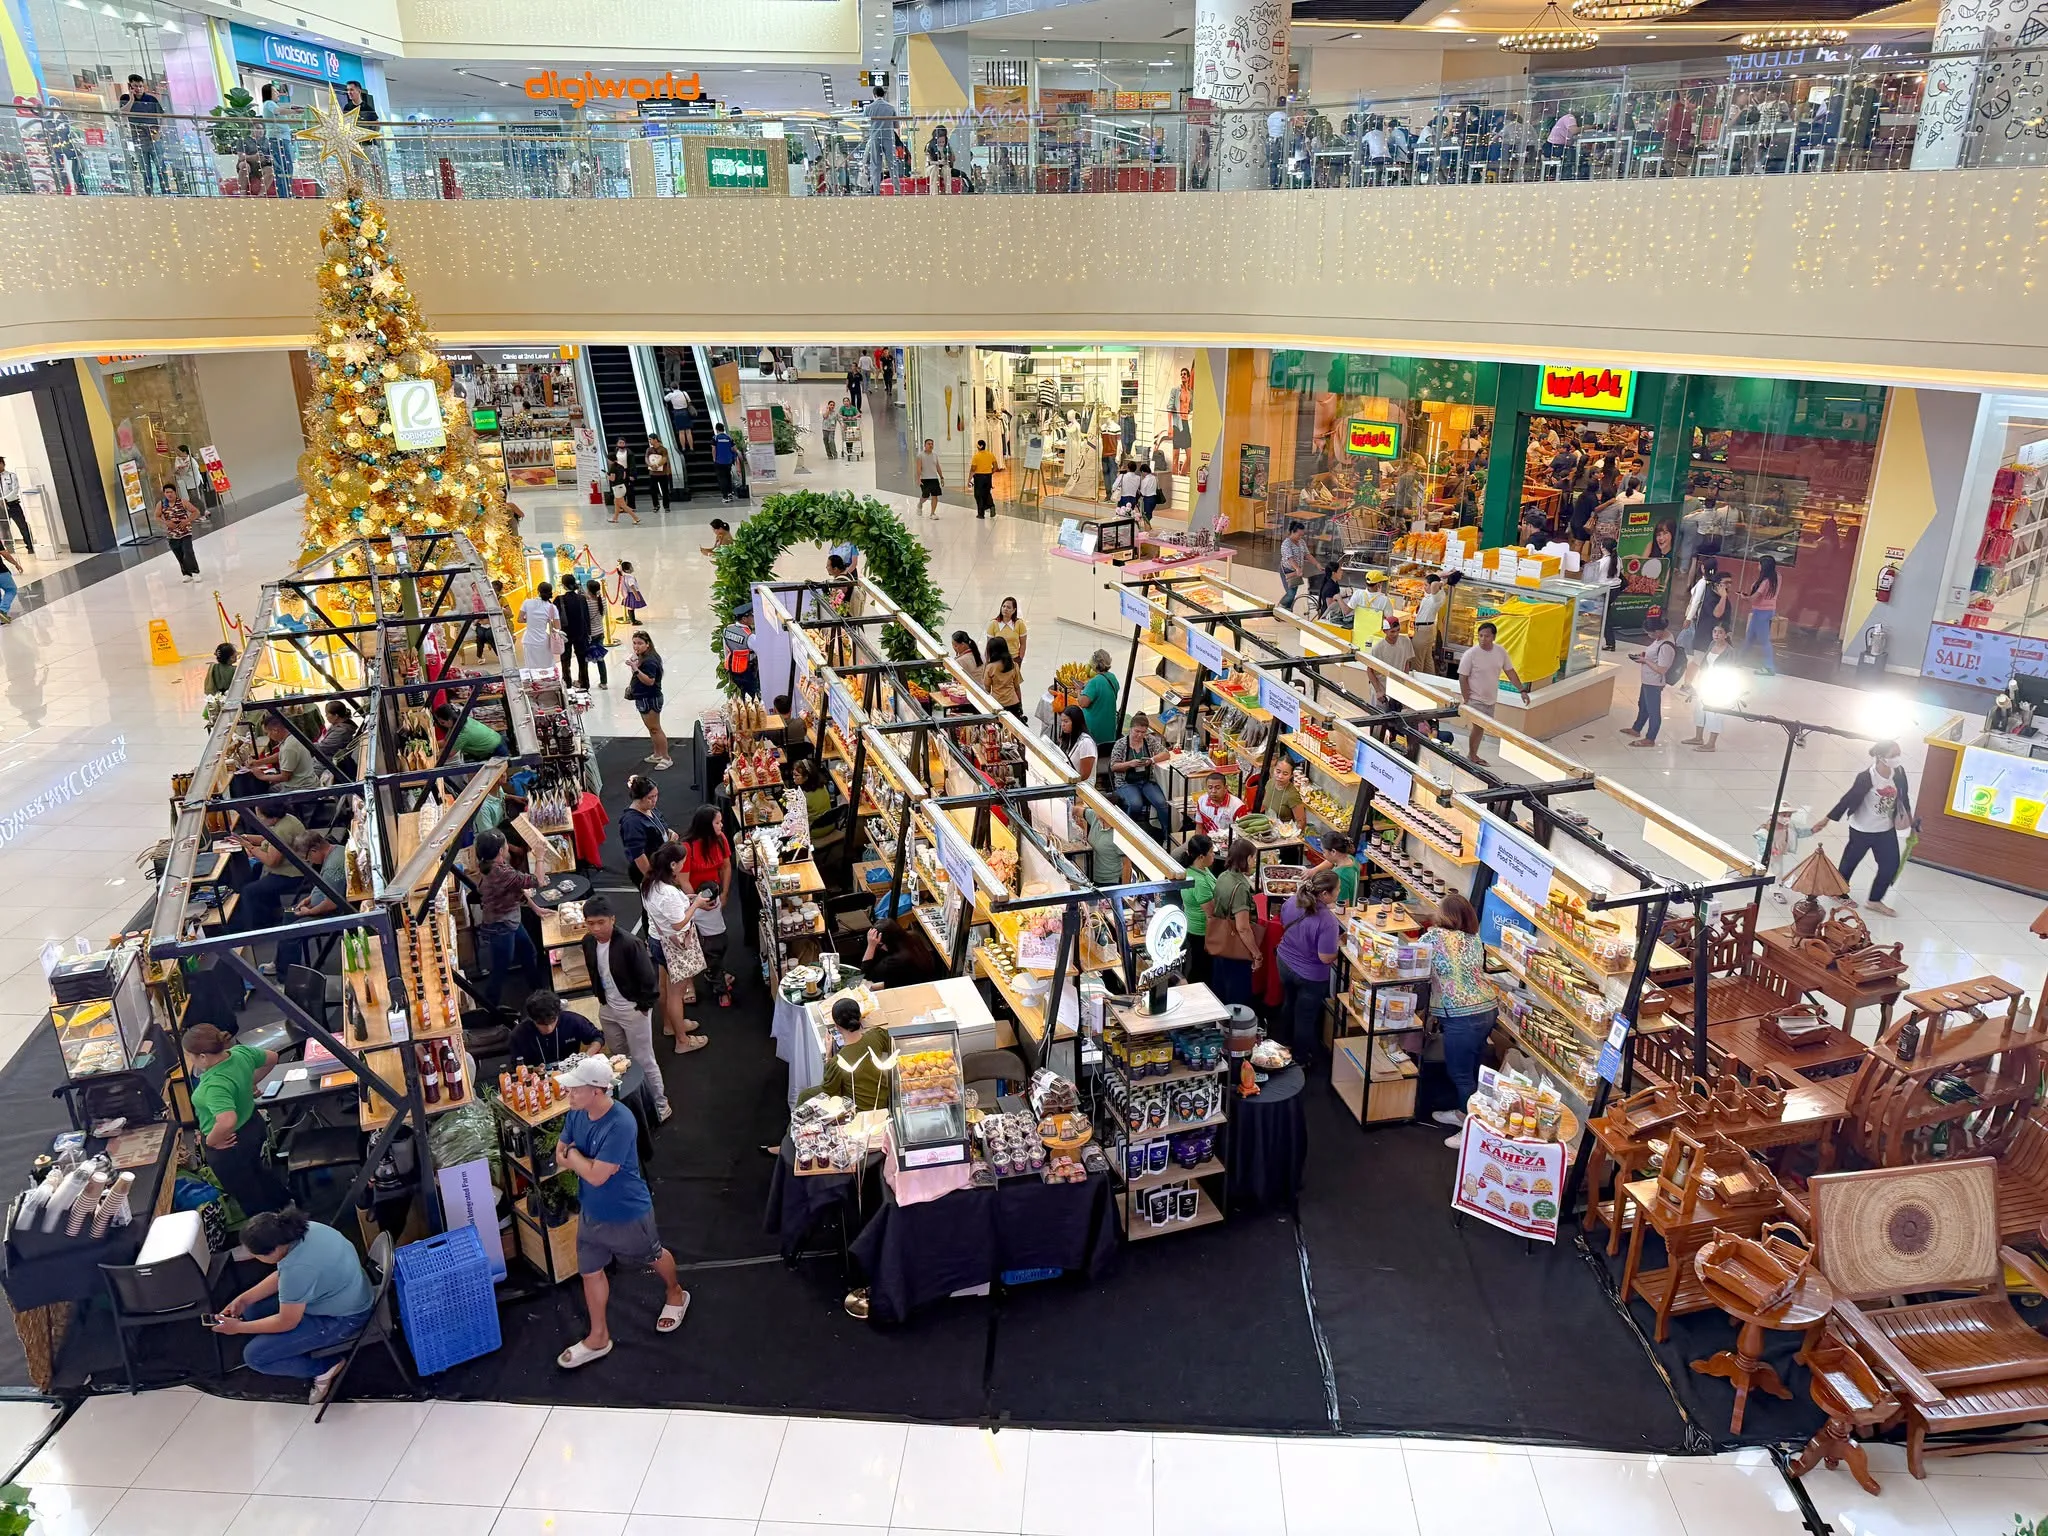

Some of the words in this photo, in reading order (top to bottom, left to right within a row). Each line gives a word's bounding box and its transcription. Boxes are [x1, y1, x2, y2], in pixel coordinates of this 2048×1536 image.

[273, 42, 319, 67] watsons
[525, 70, 699, 108] digiworld
[1215, 86, 1242, 100] TASTY
[534, 109, 557, 117] EPSON
[400, 431, 442, 439] ROBINSONS
[1935, 649, 1981, 671] SALE!
[1481, 1140, 1546, 1166] KAHEZA
